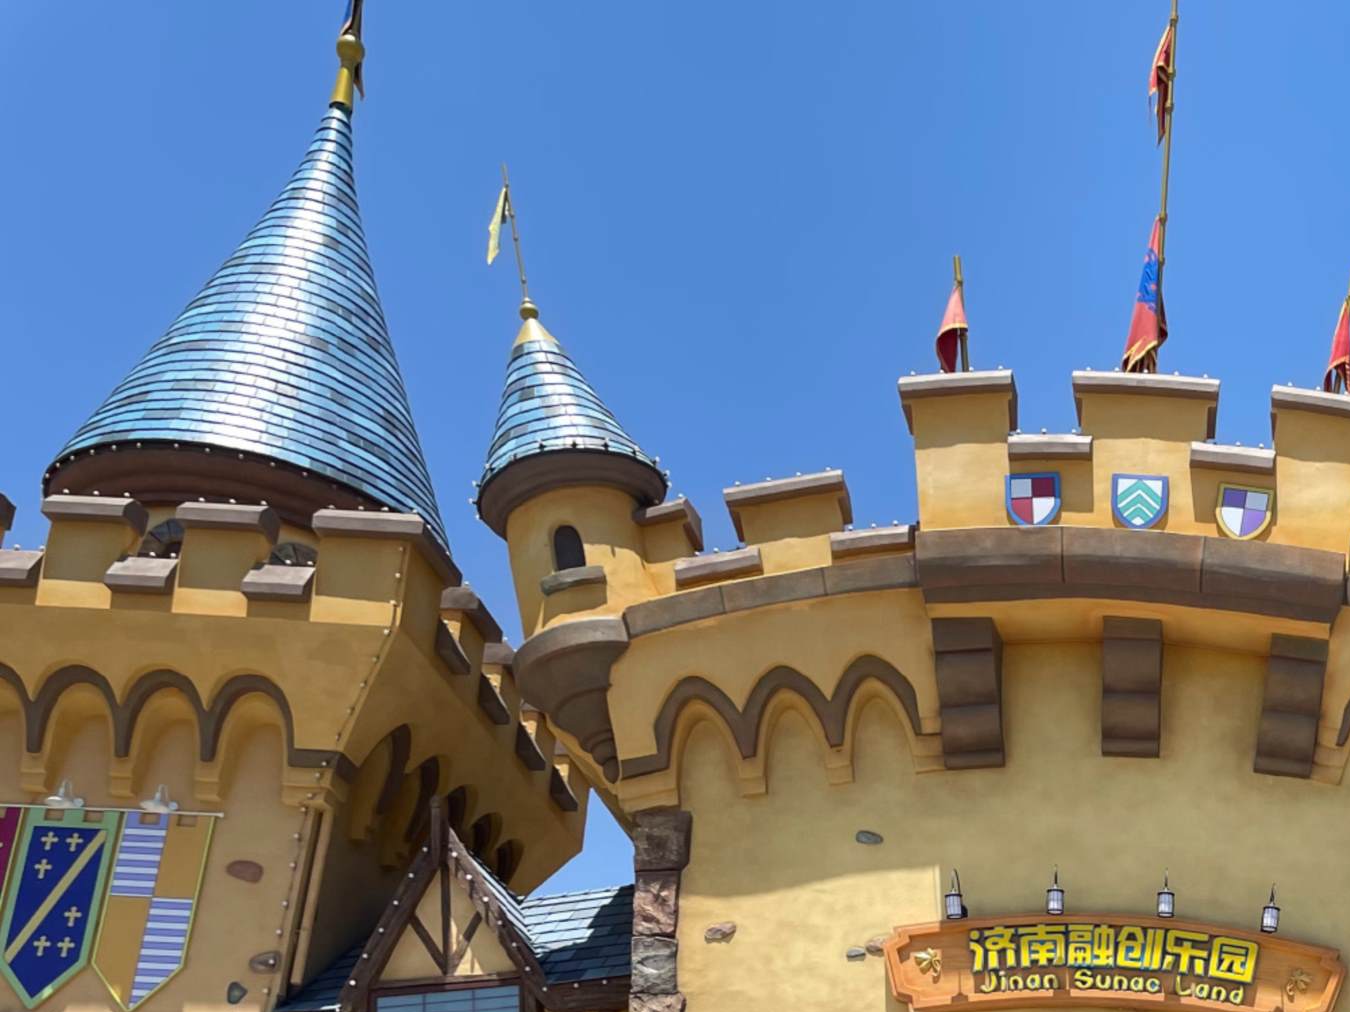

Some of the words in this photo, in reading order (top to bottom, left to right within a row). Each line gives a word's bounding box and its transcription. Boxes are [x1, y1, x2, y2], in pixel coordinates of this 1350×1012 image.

[970, 924, 1258, 983] 济南融创乐园
[980, 971, 1059, 993] Jinan
[1074, 969, 1161, 993] Sunac
[1174, 974, 1245, 1005] Land
